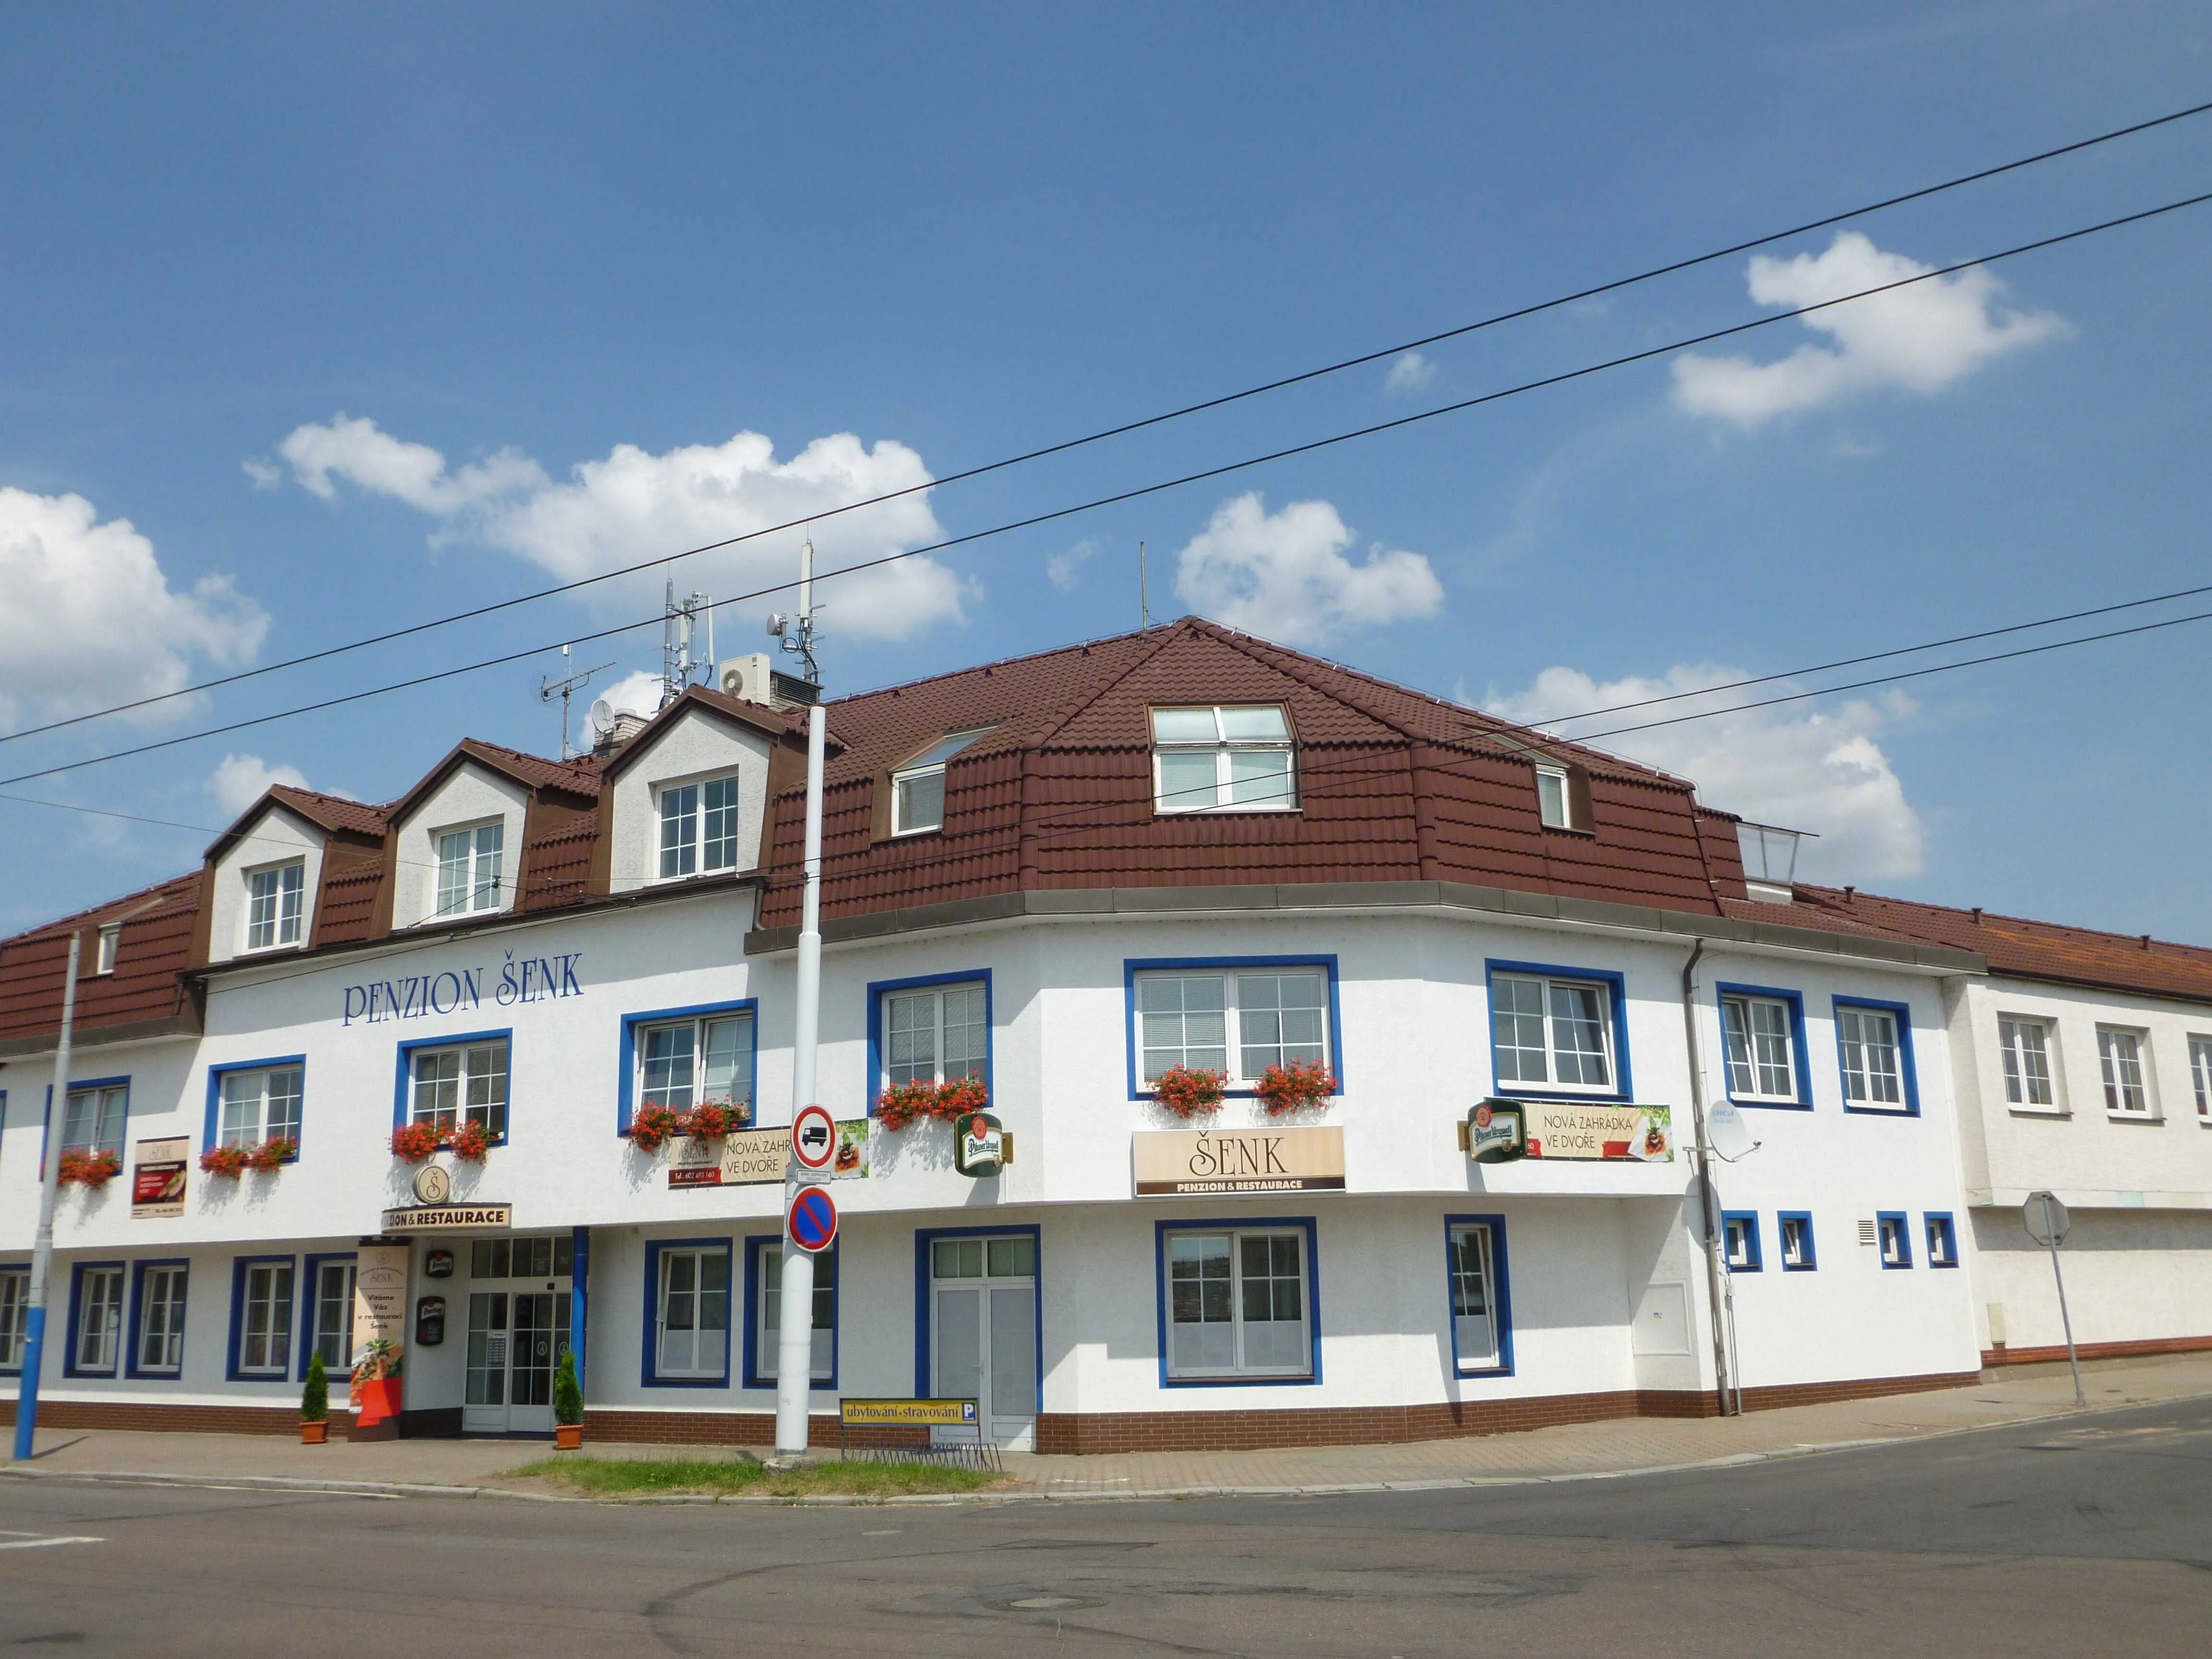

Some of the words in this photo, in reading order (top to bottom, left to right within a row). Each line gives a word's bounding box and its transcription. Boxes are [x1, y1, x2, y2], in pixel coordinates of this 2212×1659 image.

[341, 967, 484, 1027] PENZION
[495, 948, 584, 1006] ŠENK
[1544, 1112, 1577, 1129] NOVÁ
[1579, 1114, 1633, 1130] ZAHRÁDKA
[1491, 1125, 1512, 1139] Urquell
[1545, 1134, 1558, 1148] VE
[1562, 1132, 1595, 1149] DVOŘE
[727, 1137, 759, 1155] NOVÁ
[763, 1139, 791, 1153] ZAHR
[968, 1138, 986, 1157] Pilsner
[1189, 1130, 1289, 1177] ŠENK
[726, 1161, 739, 1174] VE
[743, 1156, 779, 1173] DVOŘE
[1177, 1182, 1226, 1192] PENZION
[1227, 1182, 1235, 1191] &
[1236, 1180, 1302, 1191] RESTAURACE
[409, 1214, 415, 1225] &
[417, 1210, 504, 1225] RESTAURACE
[369, 1321, 388, 1329] Šenk
[847, 1404, 899, 1421] ubytování
[902, 1406, 959, 1418] stravování
